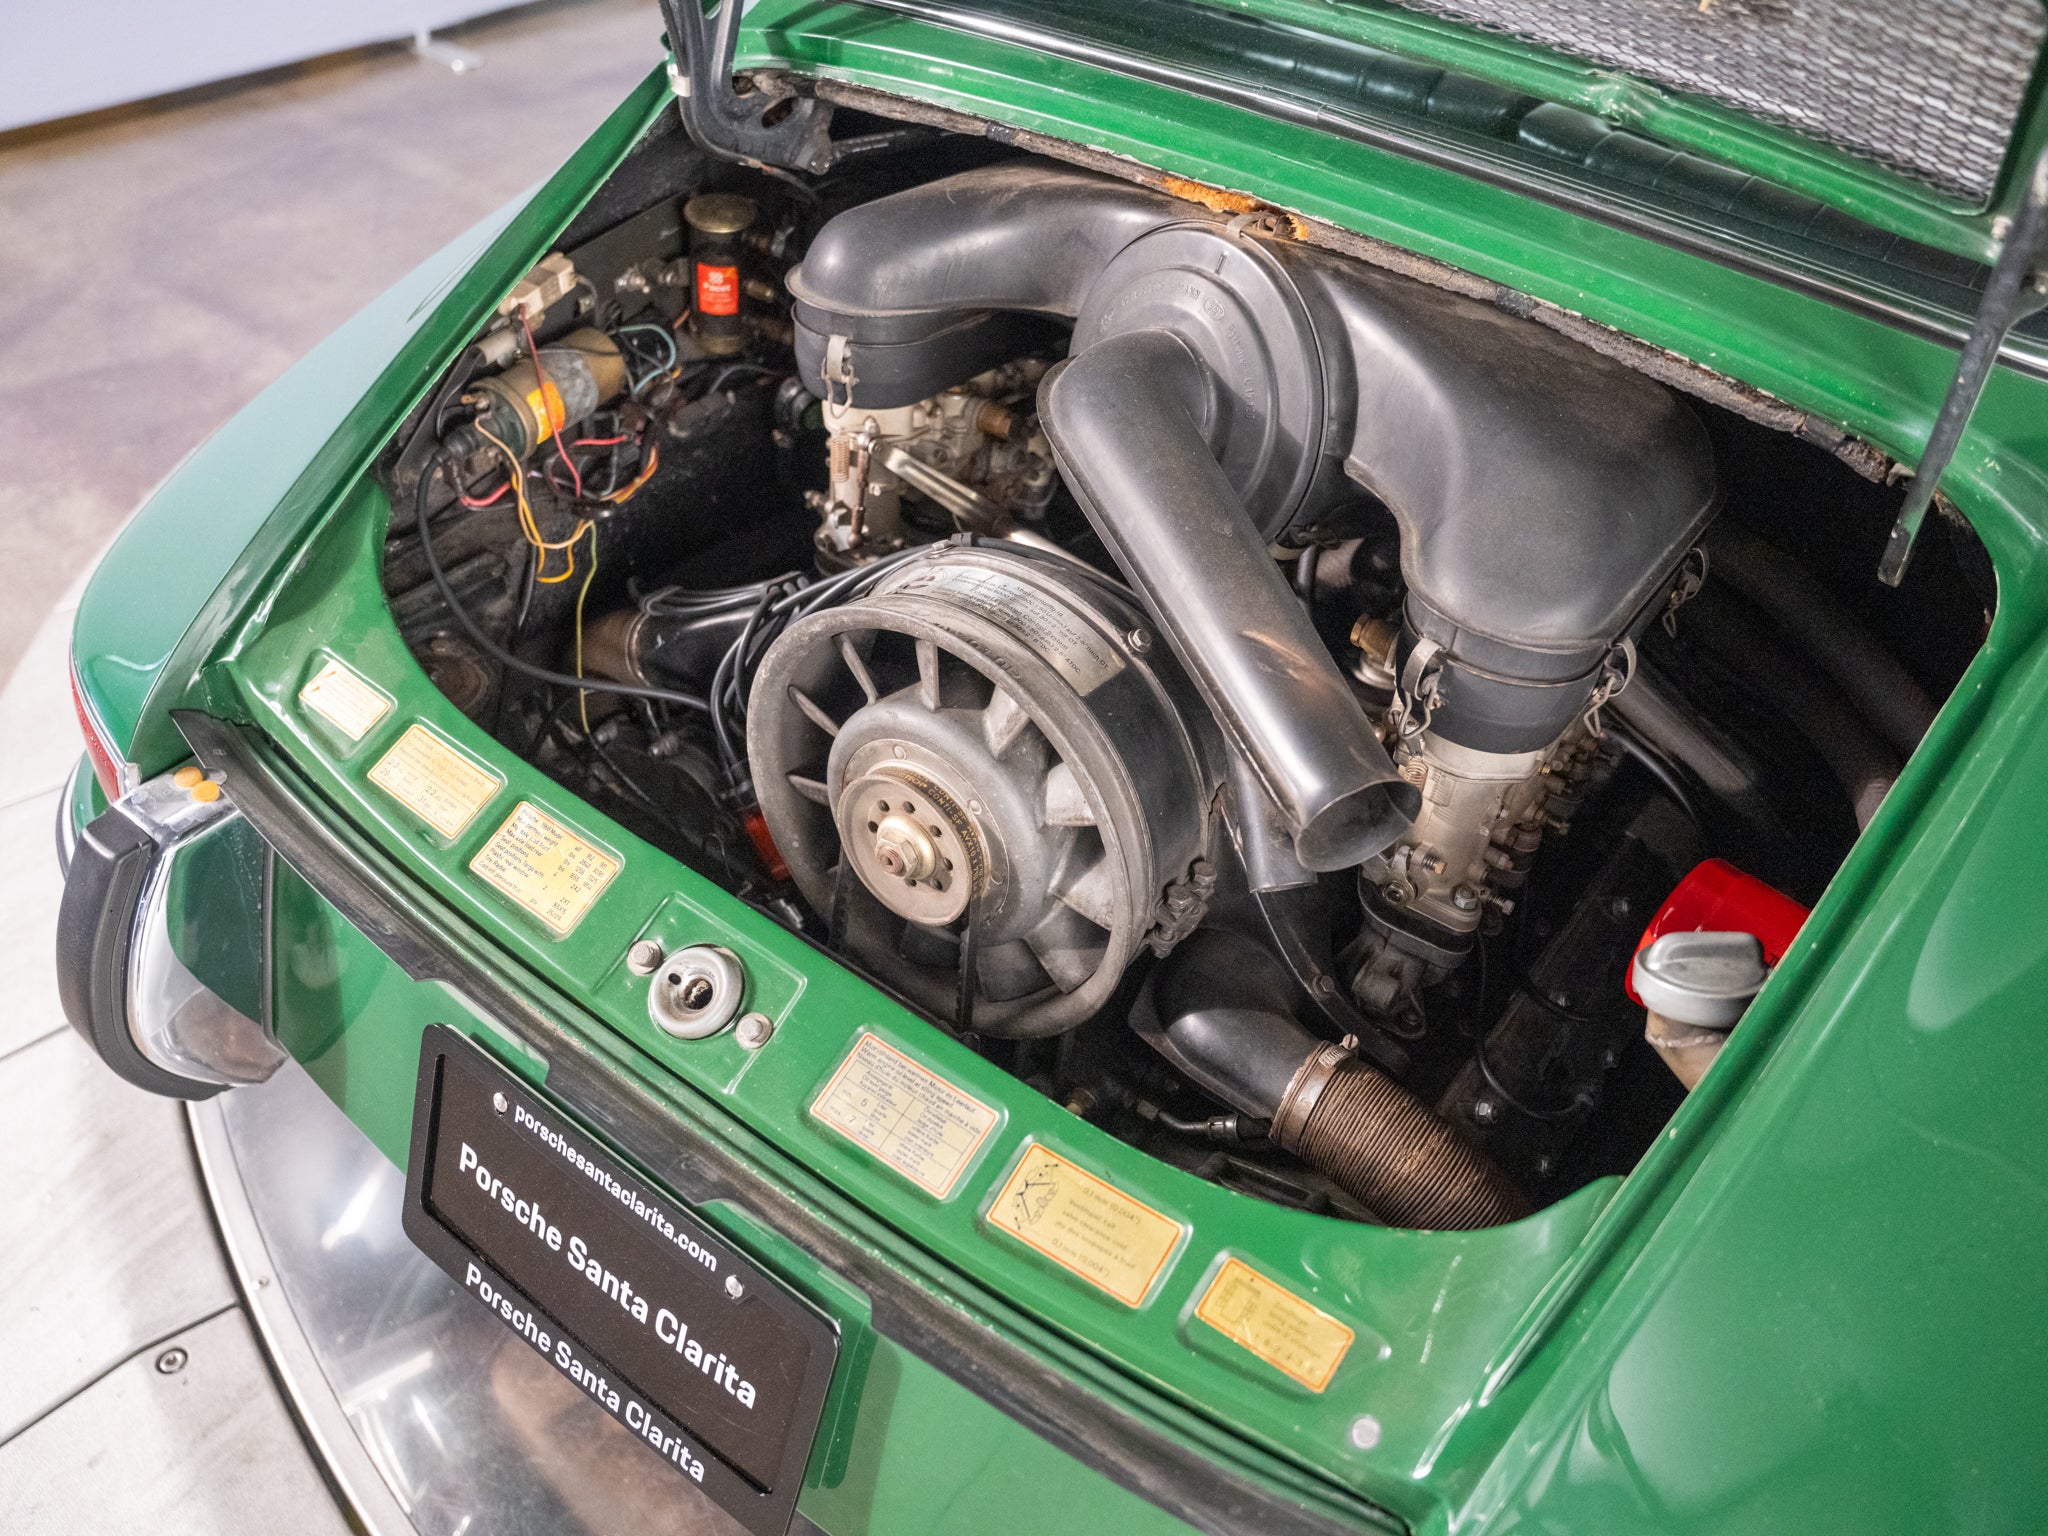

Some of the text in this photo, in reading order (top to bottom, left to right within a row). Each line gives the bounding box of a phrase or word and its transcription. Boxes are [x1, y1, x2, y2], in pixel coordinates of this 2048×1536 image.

[1023, 614, 1047, 632] Control
[1047, 630, 1068, 650] System
[928, 789, 962, 825] CONTI-SF
[848, 1115, 856, 1124] 7
[860, 1097, 869, 1107] 5
[514, 1104, 717, 1272] porschesantaclarita.com
[459, 1142, 757, 1410] Porsche Santa Clarita
[465, 1262, 705, 1483] Porsche Santa Clarita
